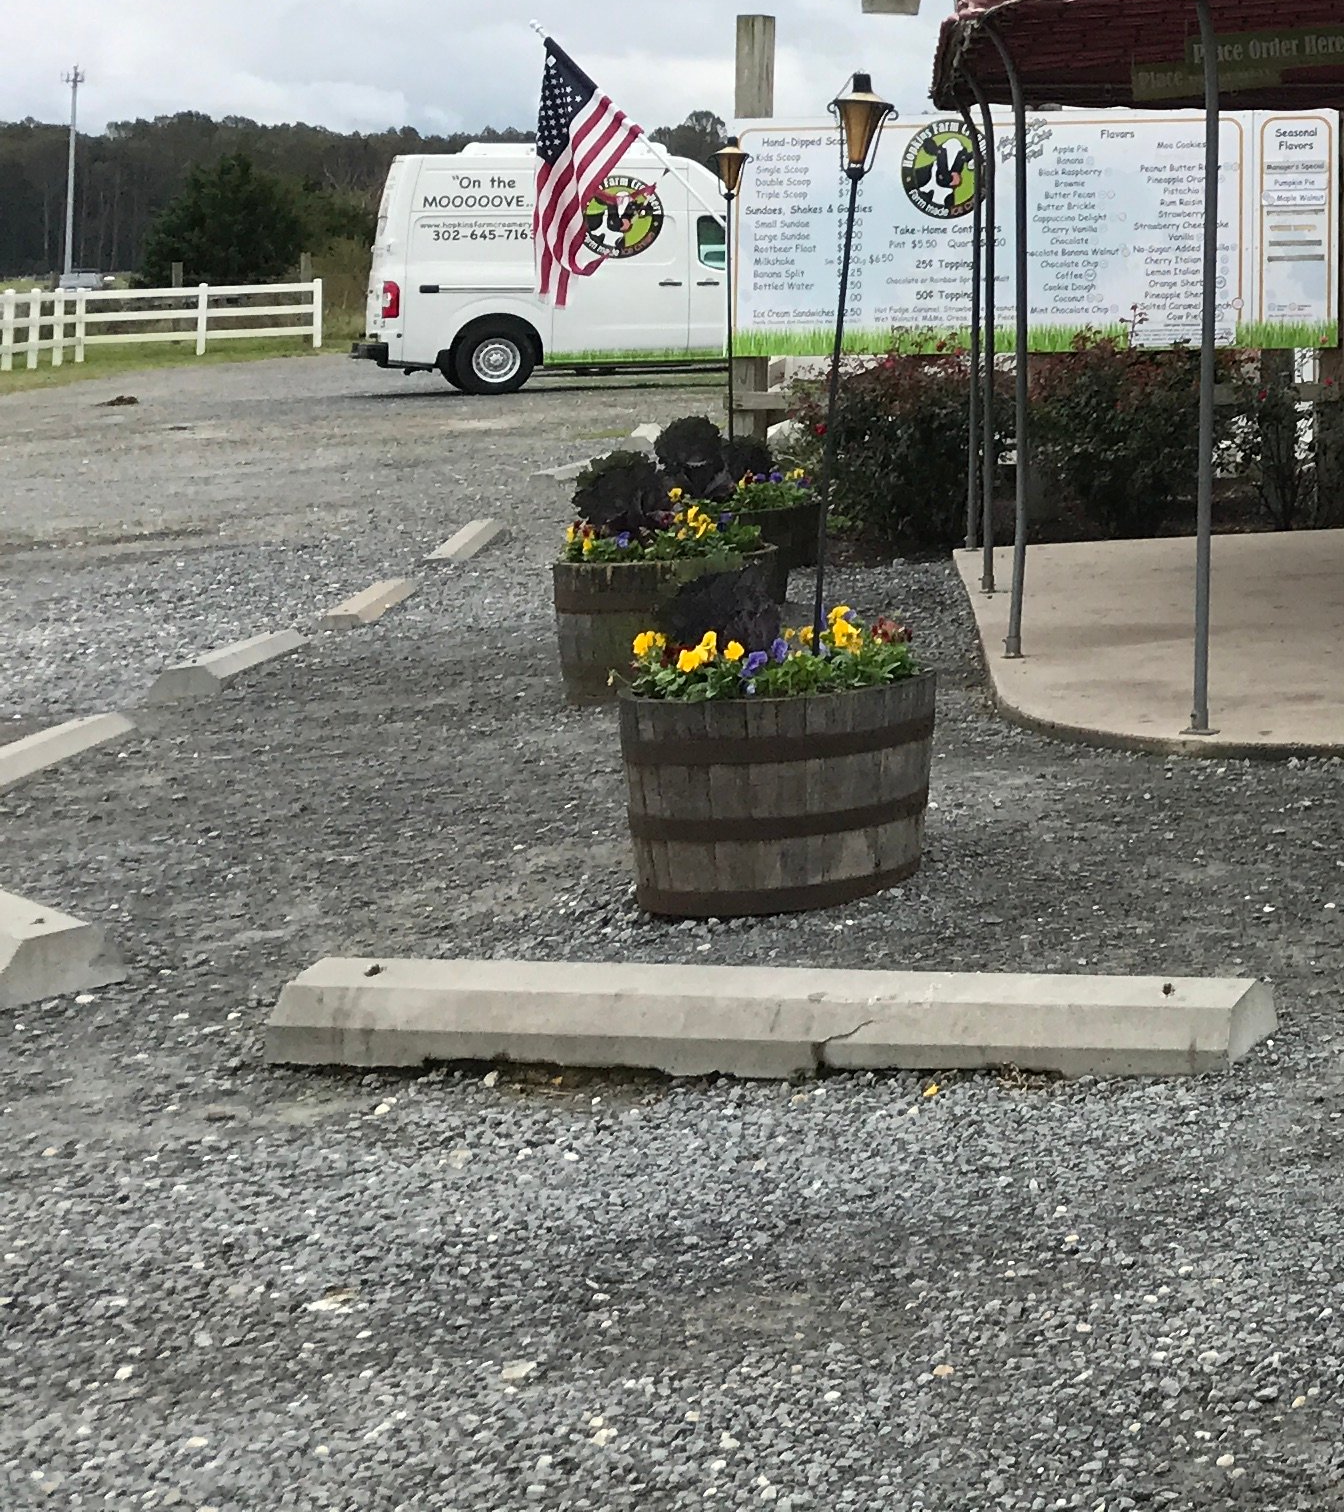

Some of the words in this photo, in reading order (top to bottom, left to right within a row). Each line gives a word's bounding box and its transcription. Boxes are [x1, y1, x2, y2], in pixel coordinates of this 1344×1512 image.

[1250, 39, 1300, 60] Order
[1100, 129, 1135, 139] Flavors
[1275, 128, 1318, 137] Seasonal
[762, 138, 822, 148] Hand-Dipped
[1278, 141, 1314, 150] Flavors
[1053, 146, 1075, 155] Apple
[1077, 144, 1089, 152] Pie
[756, 153, 774, 161] Kids
[776, 154, 801, 163] Scoop
[1056, 157, 1084, 165] Banana
[756, 166, 779, 176] Single
[782, 166, 809, 175] Scoop
[1140, 164, 1167, 172] Peanut
[1169, 163, 1196, 172] Butter
[1301, 162, 1325, 171] Special
[1038, 168, 1059, 176] Black
[1061, 168, 1103, 177] Raspberry
[490, 176, 516, 189] the
[756, 178, 784, 186] Double
[786, 178, 811, 188] Scoop
[1146, 176, 1184, 185] Pineapple
[1274, 178, 1303, 187] Pumpkin
[756, 190, 781, 200] Triple
[783, 191, 808, 201] Scoop
[1044, 191, 1071, 199] Butter
[1073, 190, 1096, 199] Pecan
[1163, 187, 1199, 195] Pistachio
[1179, 198, 1203, 206] Raisin
[1276, 194, 1297, 203] Maple
[790, 205, 823, 214] Shakes
[837, 204, 873, 214] Godies
[1036, 203, 1064, 211] Butter
[1067, 202, 1096, 211] Brickle
[1032, 214, 1076, 224] Cappuccino
[1078, 213, 1107, 224] Delight
[1158, 210, 1206, 219] Strawberry
[755, 219, 777, 228] Small
[780, 219, 810, 229] Sundae
[1134, 222, 1180, 231] Strawberry
[893, 226, 948, 234] Take-Home
[1042, 226, 1070, 235] Cherry
[754, 233, 778, 242] Large
[780, 232, 810, 240] Sundae
[1050, 237, 1089, 245] Chocolate
[1168, 233, 1195, 241] Vanilla
[753, 244, 793, 253] Rootbeer
[795, 244, 816, 253] Float
[889, 240, 906, 249] Pint
[947, 239, 974, 249] Quar
[1061, 248, 1089, 257] Banana
[1091, 247, 1120, 256] Walnut
[753, 257, 795, 266] Milkshake
[1040, 260, 1079, 268] Chocolate
[1145, 257, 1172, 265] Cherry
[1174, 256, 1201, 265] Italian
[753, 270, 782, 278] Banana
[785, 269, 805, 279] Split
[1055, 271, 1083, 280] Coffee
[1145, 268, 1172, 276] Lemon
[1173, 267, 1200, 276] Italian
[753, 282, 785, 291] Bottled
[788, 282, 814, 291] Water
[1043, 283, 1069, 291] Cookie
[1071, 283, 1097, 293] Dough
[1148, 279, 1177, 289] Orange
[1054, 295, 1085, 303] Coconut
[1144, 291, 1181, 300] Pineapple
[1051, 306, 1090, 314] Chocolate
[1139, 302, 1167, 311] Salted
[1168, 301, 1201, 310] Caramel
[793, 308, 835, 317] Sandwiches
[1166, 312, 1184, 320] Cow
